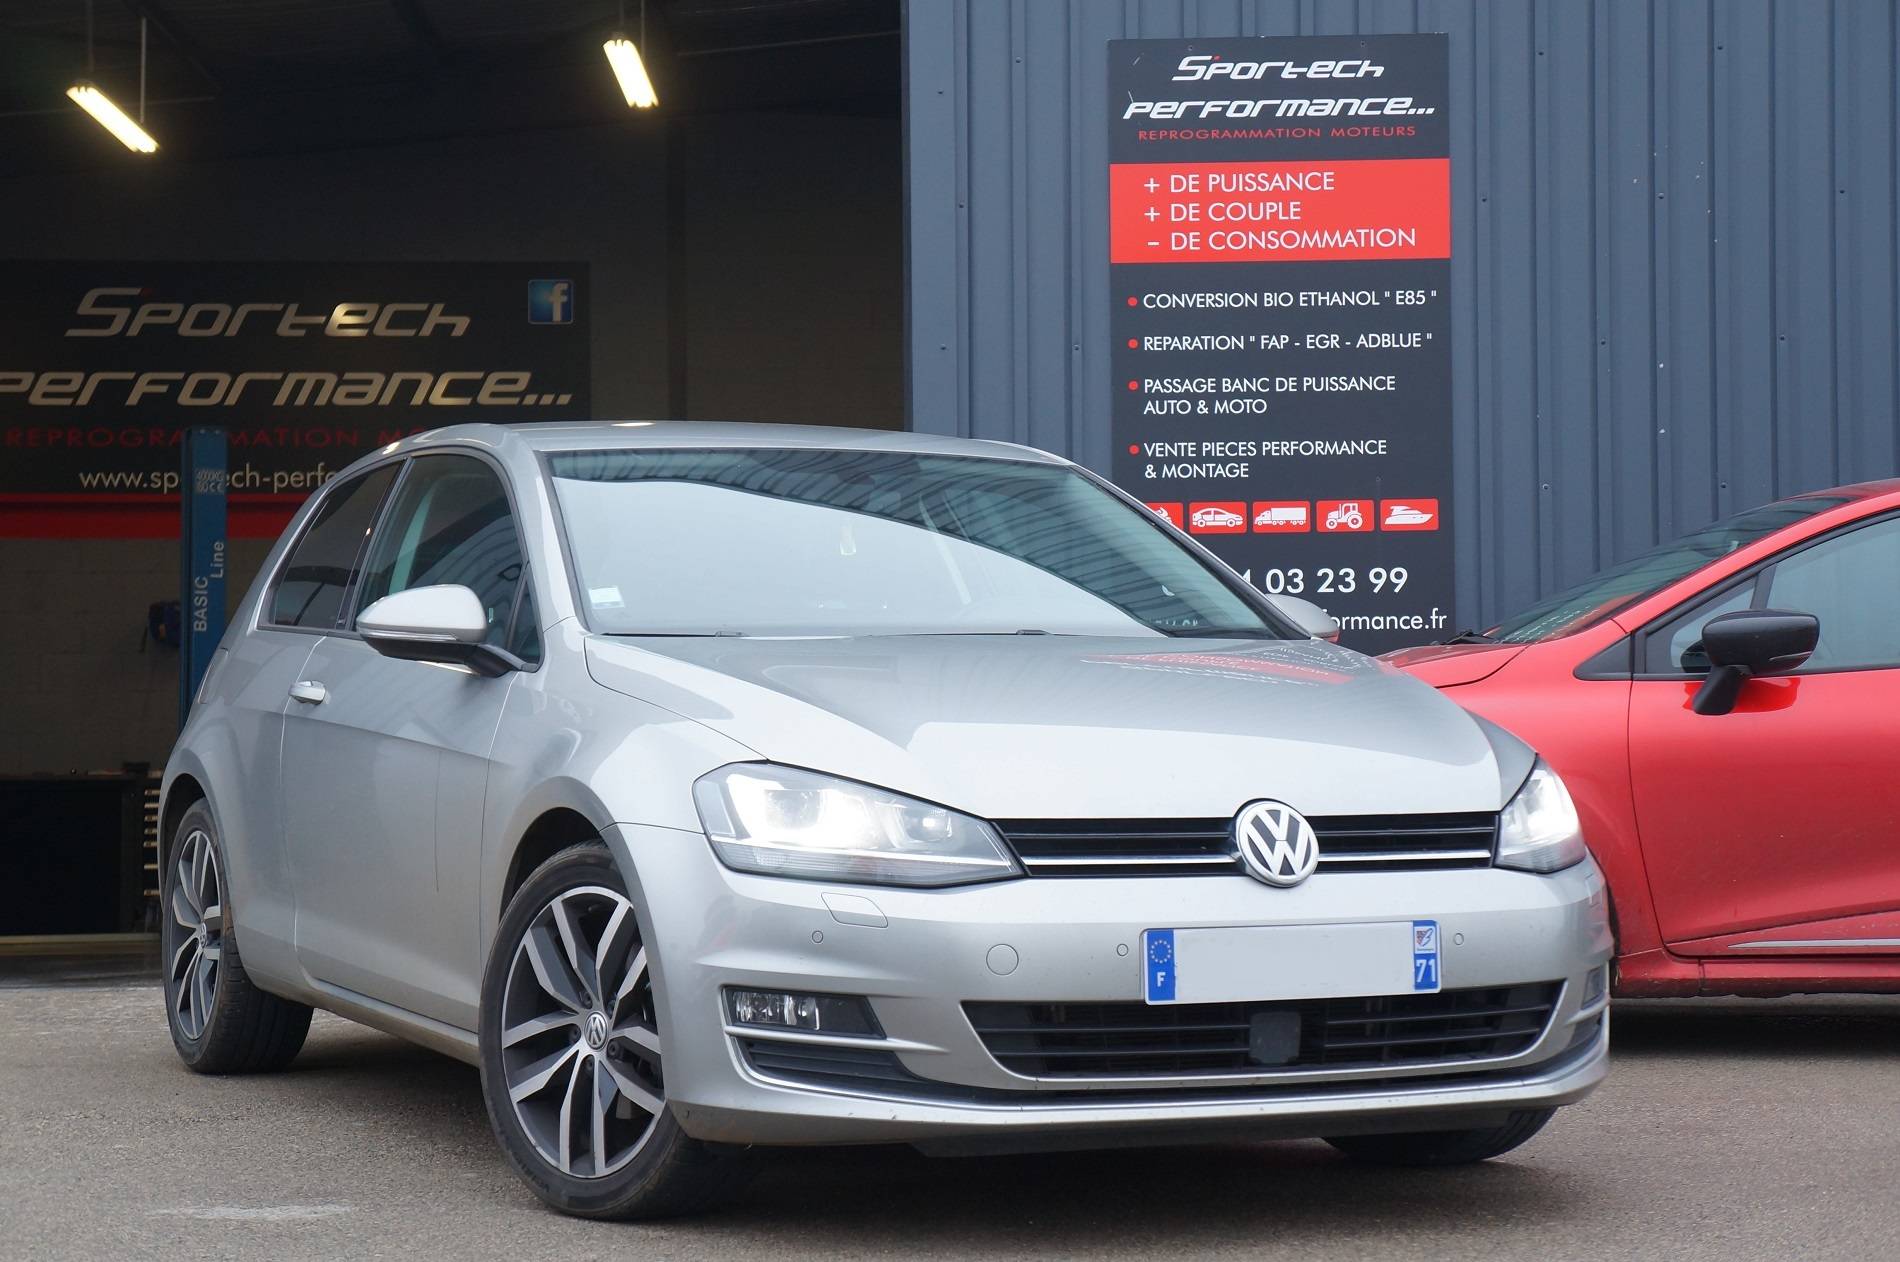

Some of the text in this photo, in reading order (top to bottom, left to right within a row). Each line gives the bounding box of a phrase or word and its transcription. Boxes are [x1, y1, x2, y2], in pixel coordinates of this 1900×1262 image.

[1138, 126, 1416, 141] REPROGRAMMATION MOTEURS
[1171, 175, 1199, 192] DE
[1209, 172, 1334, 192] PUISSANCE
[1171, 204, 1200, 221] DE
[1209, 202, 1300, 221] COUPLE
[1172, 232, 1200, 250] DE
[1209, 229, 1415, 250] CONSOMMATION
[1144, 293, 1257, 308] CONVERSION
[1264, 292, 1293, 306] BIO
[1300, 291, 1380, 306] ETHANOL
[1396, 291, 1425, 304] E85
[1145, 336, 1244, 350] REPARATION
[1261, 335, 1289, 349] FAP
[1307, 334, 1340, 348] EGR
[1356, 333, 1421, 348] ADBLUE
[1145, 376, 1395, 393] PASSAGE BANC DE PUISSANCE
[1144, 399, 1267, 414] AUTO & MOTO
[4, 424, 359, 449] REPROGRAMATION
[1144, 440, 1386, 456] VENTE PIECES PERFORMANCE
[1145, 463, 1248, 478] & MONTAGE
[210, 540, 225, 579] Line
[1265, 569, 1304, 594] 03
[1317, 568, 1355, 592] 23
[1369, 567, 1407, 593] 99
[194, 575, 209, 632] BASIC
[1322, 608, 1447, 630] rmance.fr
[1157, 972, 1165, 986] F
[1416, 959, 1435, 982] 71
